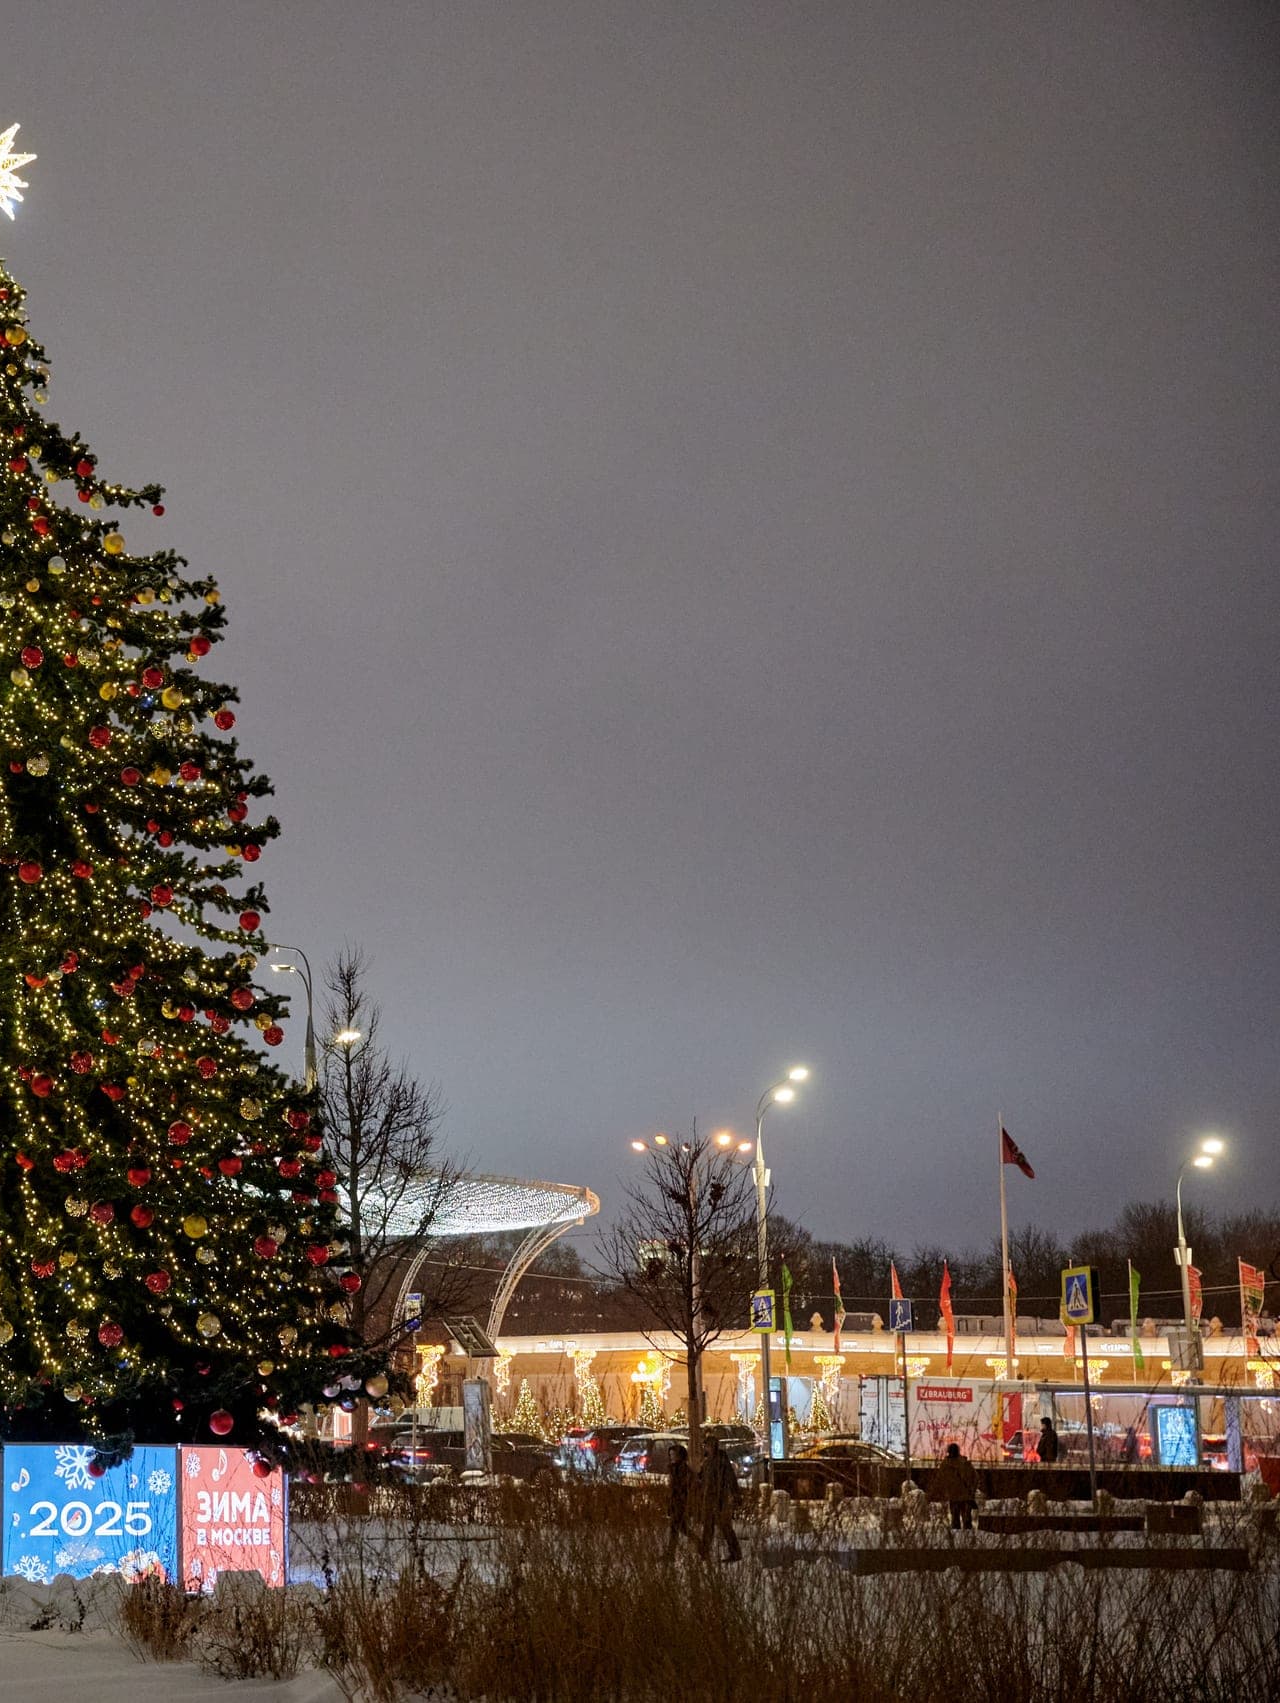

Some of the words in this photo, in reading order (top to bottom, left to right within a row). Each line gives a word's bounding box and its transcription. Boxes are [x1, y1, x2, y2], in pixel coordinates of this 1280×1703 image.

[29, 1501, 152, 1536] 2025
[197, 1491, 270, 1523] ЗИМА
[197, 1529, 206, 1545] В
[211, 1529, 271, 1545] МОСКВЕ
